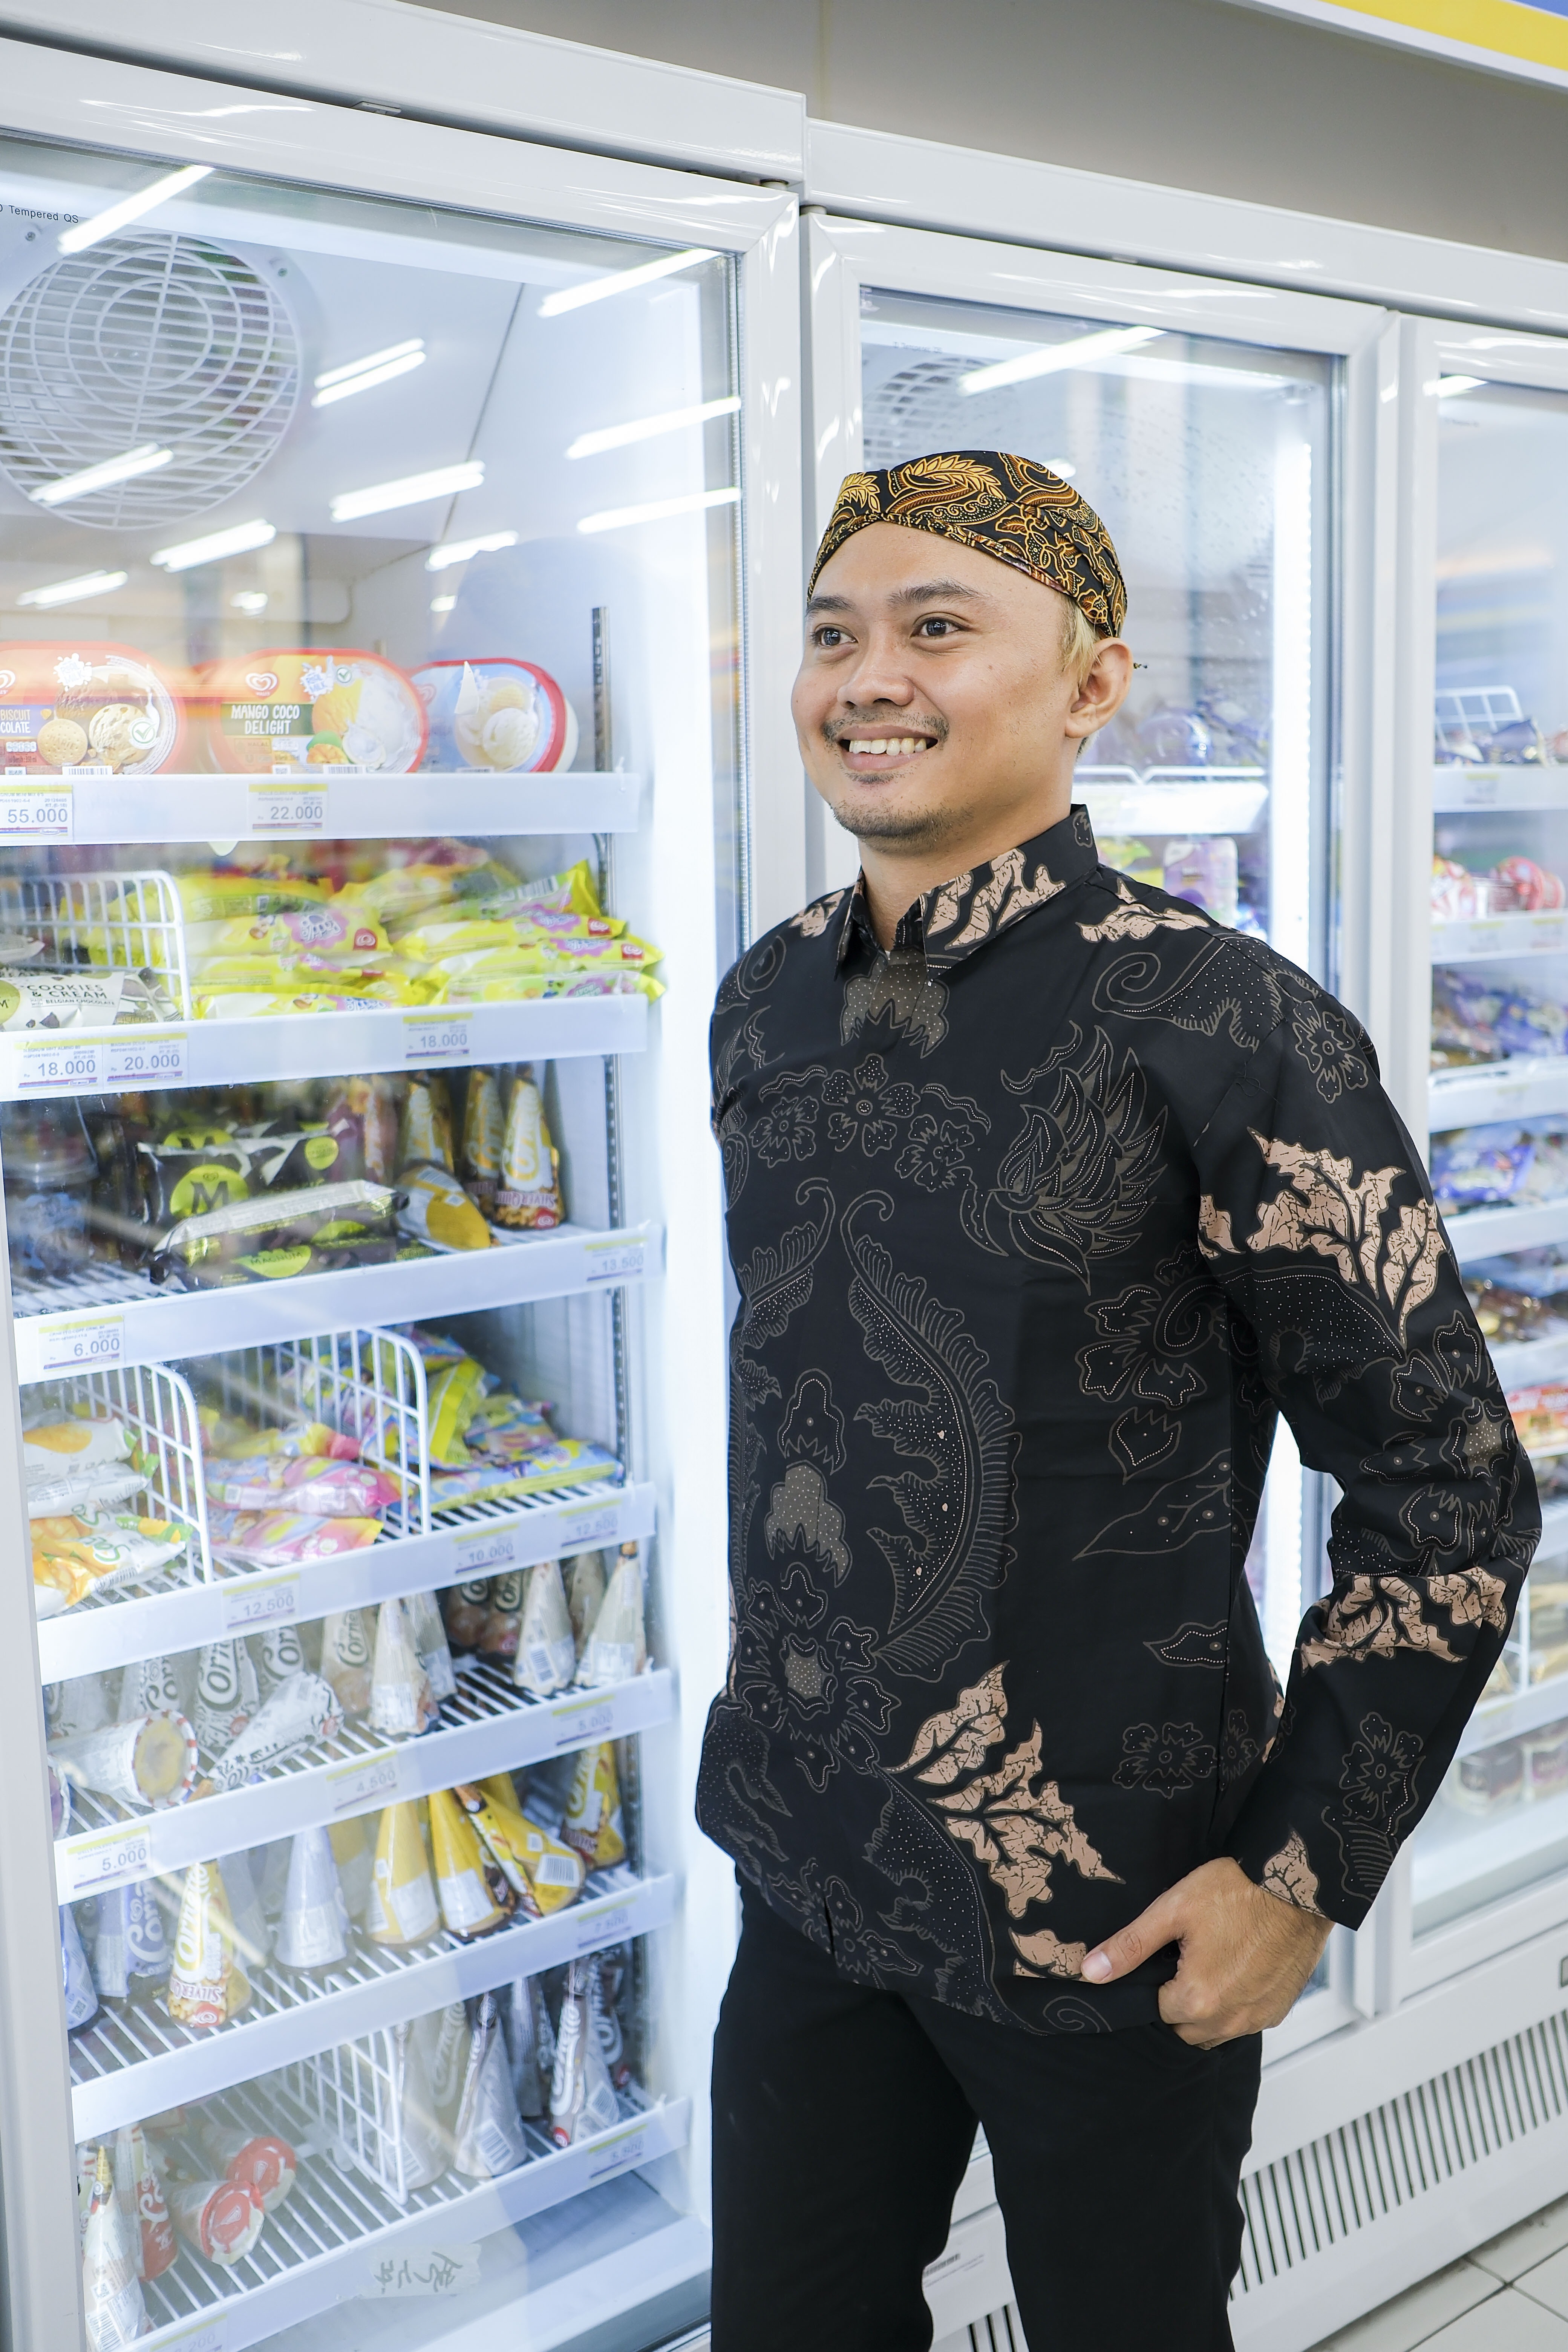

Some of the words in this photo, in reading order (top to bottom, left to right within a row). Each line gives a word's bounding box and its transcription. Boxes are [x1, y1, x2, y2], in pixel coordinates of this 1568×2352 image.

[8, 205, 58, 220] Tempered
[64, 214, 78, 223] QS
[0, 709, 31, 721] BISCUIT
[231, 704, 269, 719] MANGO
[273, 704, 300, 719] COCO
[0, 721, 31, 733] COLATE
[245, 720, 291, 734] DELIGHT
[8, 808, 68, 823] 55.000
[271, 806, 323, 820] 22.000
[420, 1033, 467, 1048] 18.000
[38, 1060, 96, 1076] 18.000
[124, 1054, 180, 1070] 20.000
[250, 1251, 303, 1265] MAGNUM
[602, 1254, 643, 1271] 13.500
[74, 1338, 120, 1357] 6.000
[576, 1517, 618, 1536] 12.500
[469, 1543, 513, 1562] 10.000
[243, 1595, 294, 1616] 12.500
[102, 1848, 146, 1871] 5.000
